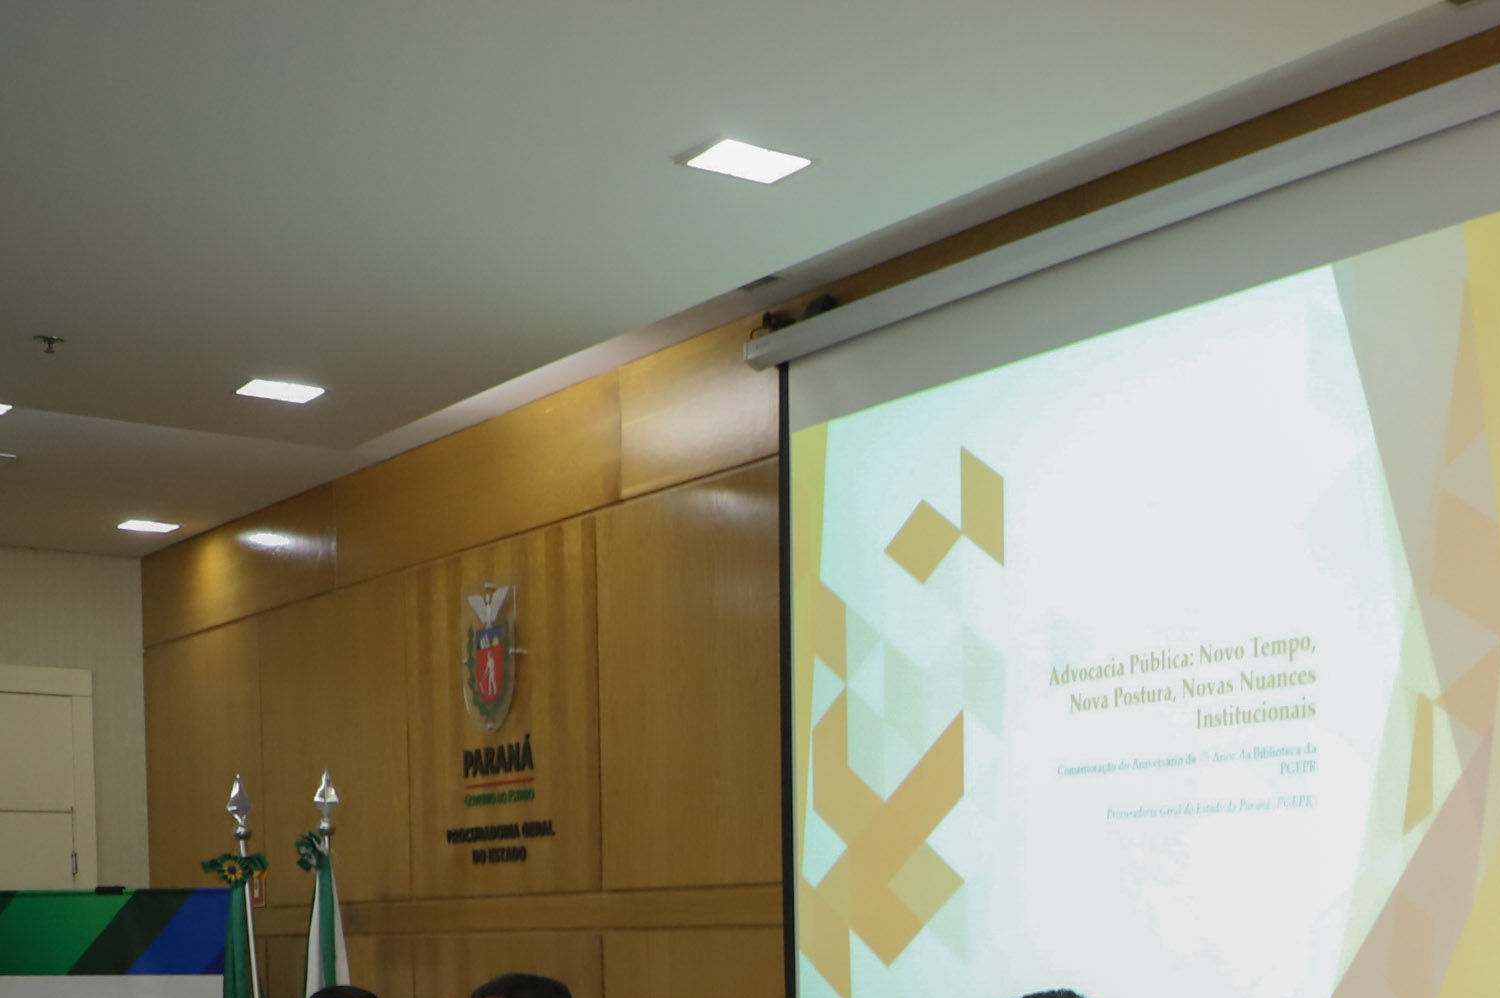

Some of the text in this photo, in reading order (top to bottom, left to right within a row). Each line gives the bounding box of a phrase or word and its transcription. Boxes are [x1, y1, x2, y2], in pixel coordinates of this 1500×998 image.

[1049, 634, 1317, 687] Advocacia Pública: Novo Tempo,
[1070, 668, 1317, 713] Nova Postura, Novas Nuances
[1197, 696, 1317, 729] Institucionais
[463, 733, 534, 779] PARANÁ
[1304, 742, 1318, 754] da
